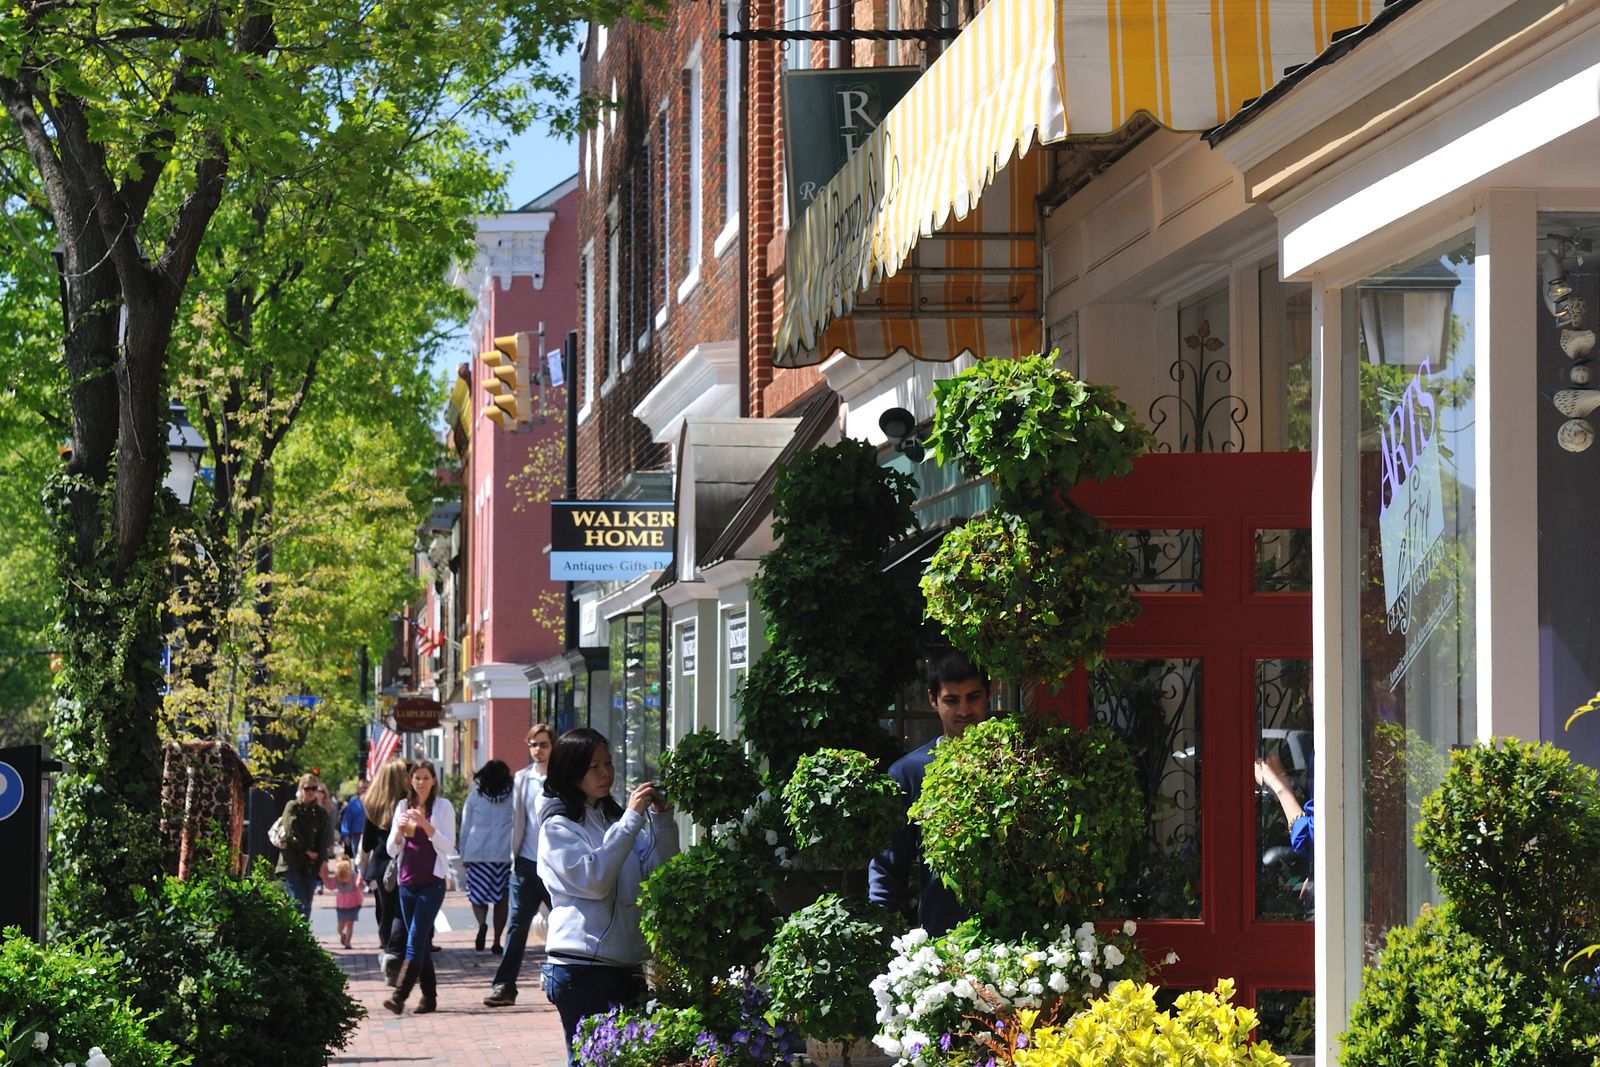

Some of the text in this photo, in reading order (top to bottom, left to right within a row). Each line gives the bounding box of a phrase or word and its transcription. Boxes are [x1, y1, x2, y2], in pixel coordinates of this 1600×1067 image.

[837, 90, 878, 129] R
[1379, 352, 1436, 520] ARTS
[571, 510, 676, 528] WALKER
[584, 529, 665, 547] HOME
[1386, 586, 1409, 635] GLASS
